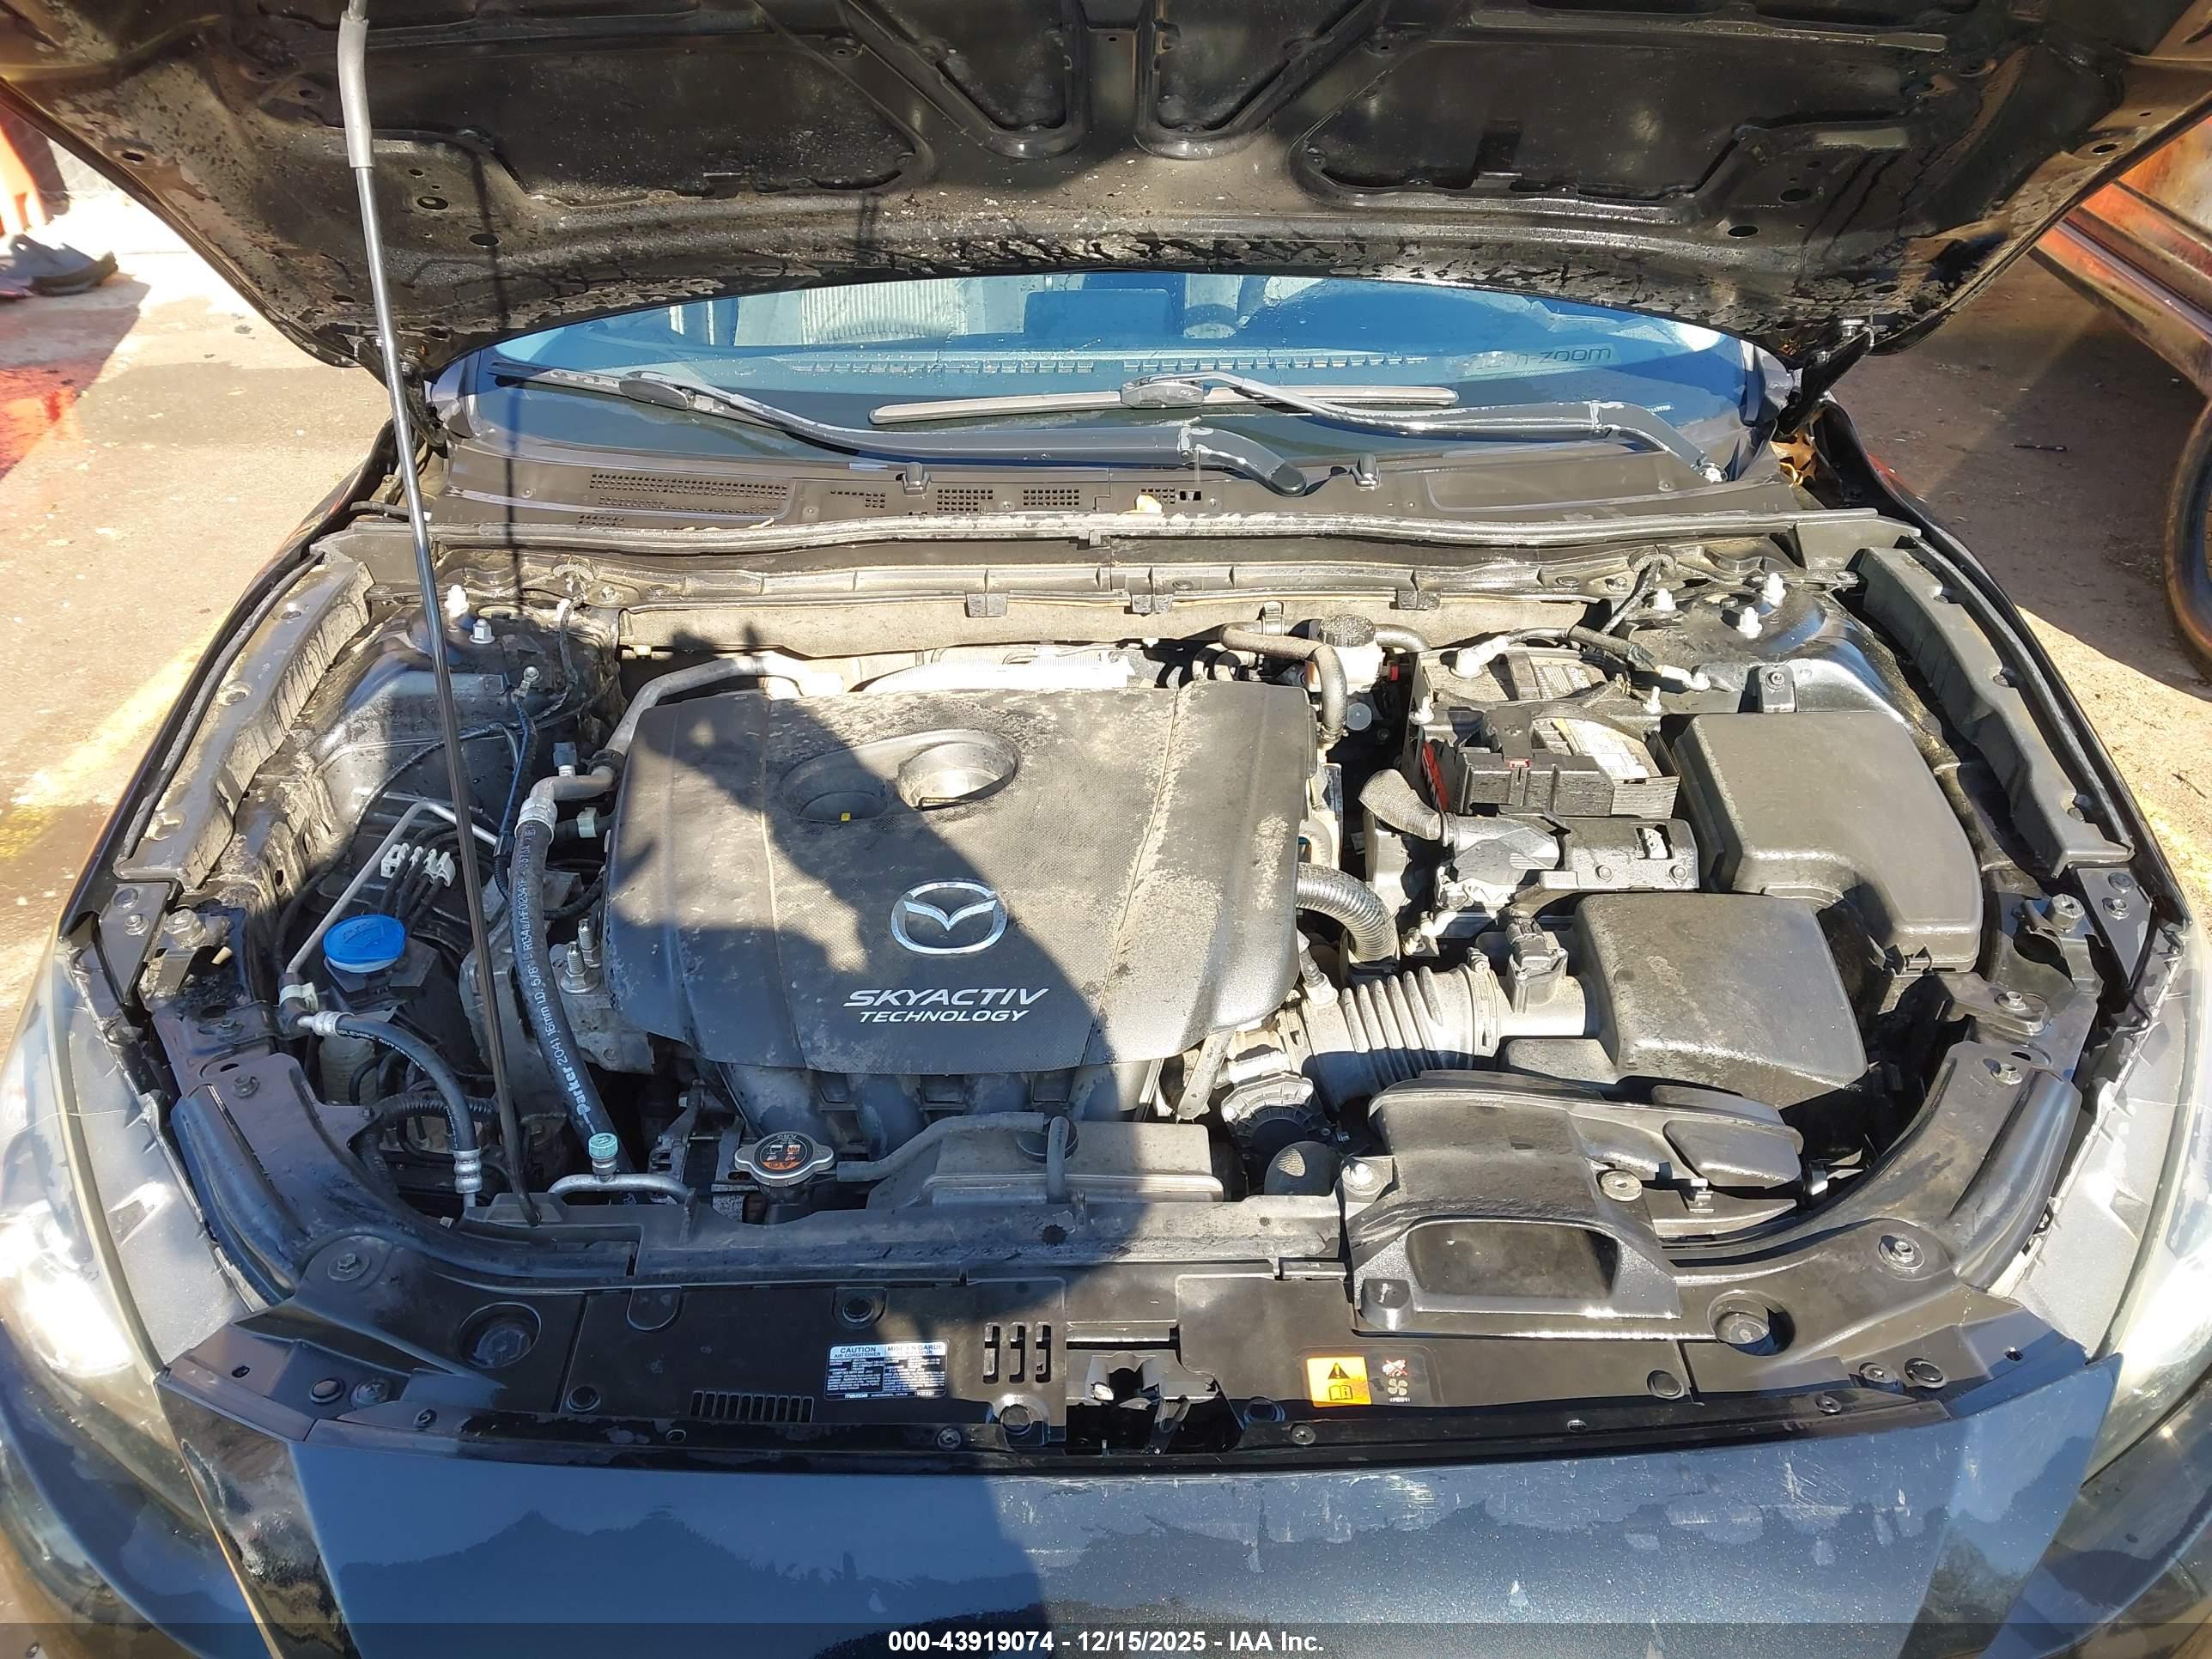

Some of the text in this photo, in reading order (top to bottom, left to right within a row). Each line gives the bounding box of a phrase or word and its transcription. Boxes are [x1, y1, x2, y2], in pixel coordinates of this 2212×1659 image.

[843, 988, 1049, 1007] SKYACTIV
[540, 1006, 556, 1036] 16mm
[860, 1010, 1030, 1023] TECHNOLOGY
[550, 1037, 568, 1065] 2041
[562, 1066, 591, 1115] Parker
